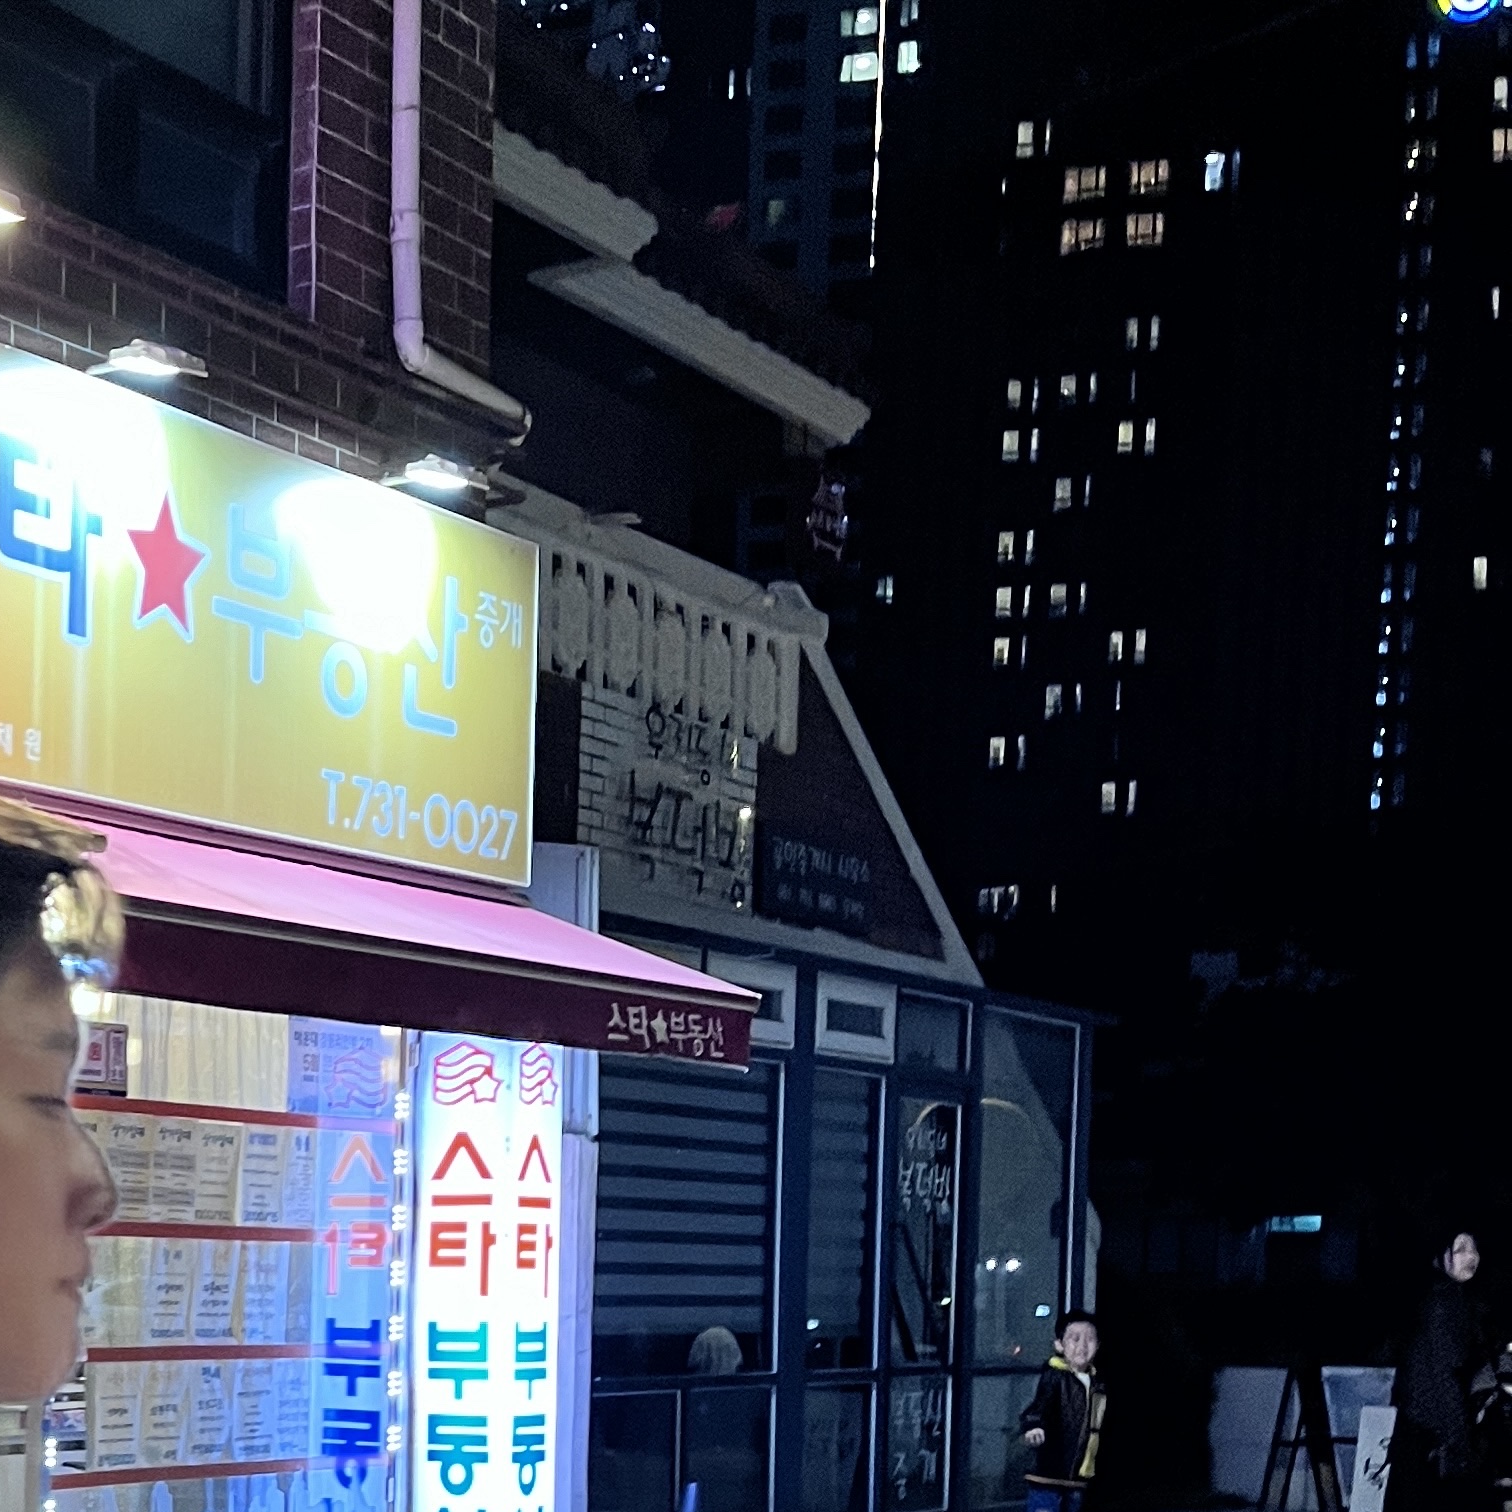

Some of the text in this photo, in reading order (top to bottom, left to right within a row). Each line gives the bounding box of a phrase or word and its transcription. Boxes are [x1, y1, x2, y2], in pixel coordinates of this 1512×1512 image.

[474, 590, 523, 651] 중개
[321, 767, 518, 861] T.731-0027
[607, 1002, 726, 1059] 스타 부동산
